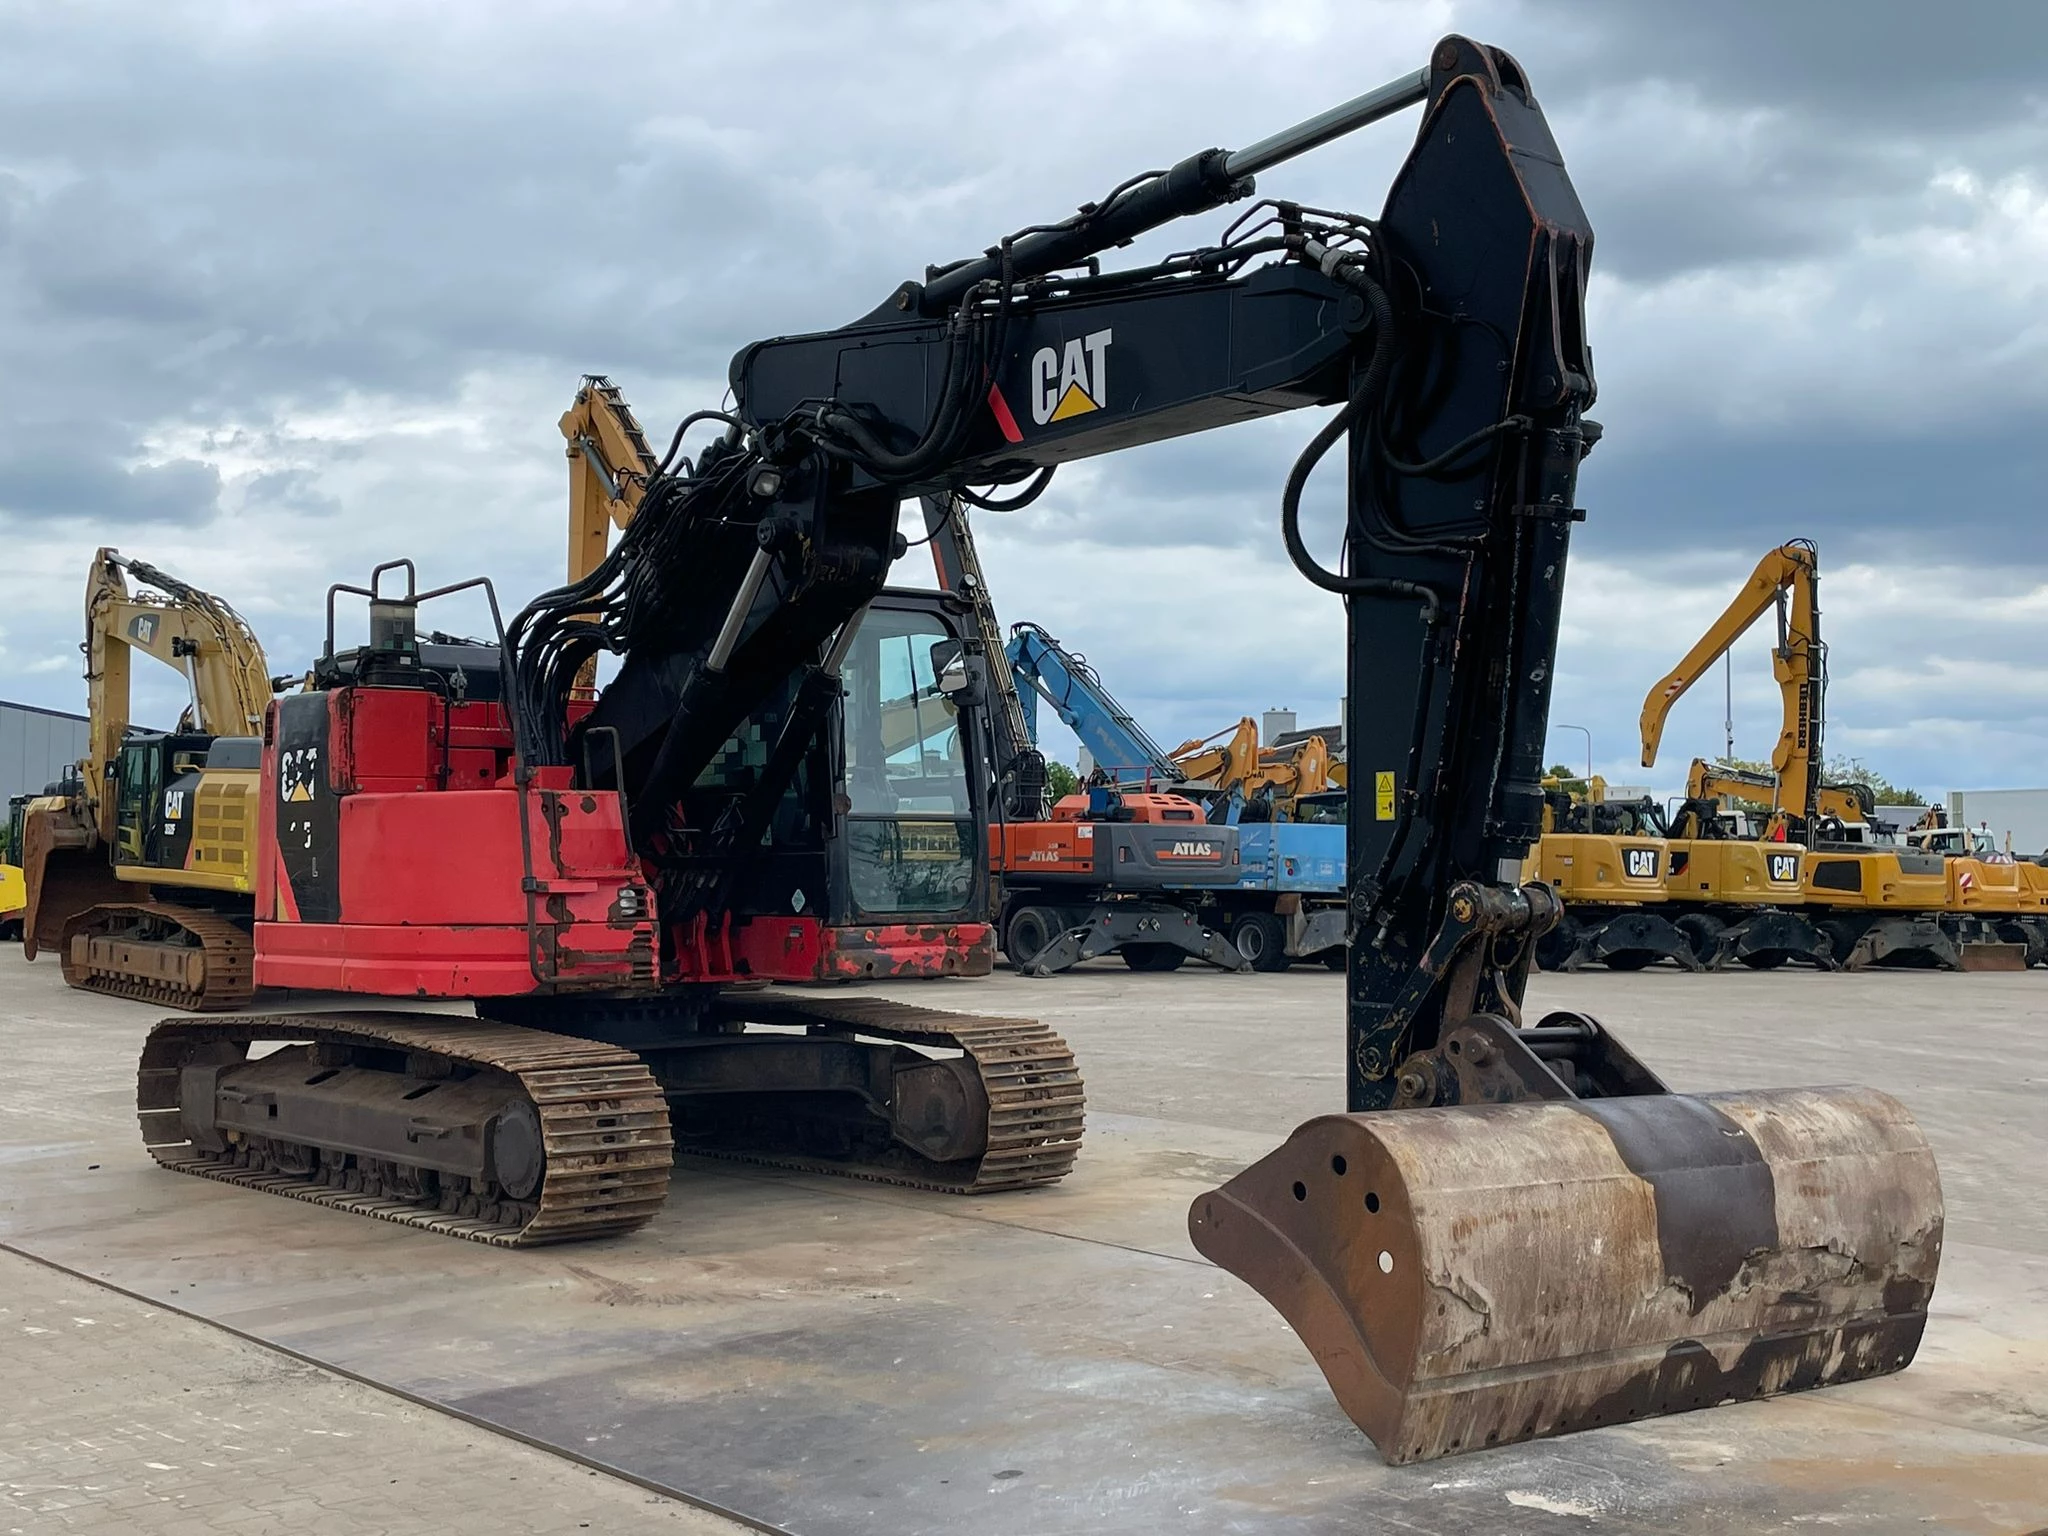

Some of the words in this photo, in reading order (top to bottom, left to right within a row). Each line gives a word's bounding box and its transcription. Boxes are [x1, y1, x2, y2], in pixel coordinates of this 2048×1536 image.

[1031, 327, 1112, 426] CAT
[138, 617, 153, 643] CAT
[1798, 683, 1808, 749] LIEBHERR
[164, 790, 185, 819] CAT
[1028, 850, 1060, 862] ATLAS
[1172, 841, 1212, 857] ATLAS
[1629, 850, 1655, 876] CAT
[1773, 855, 1796, 880] CAT
